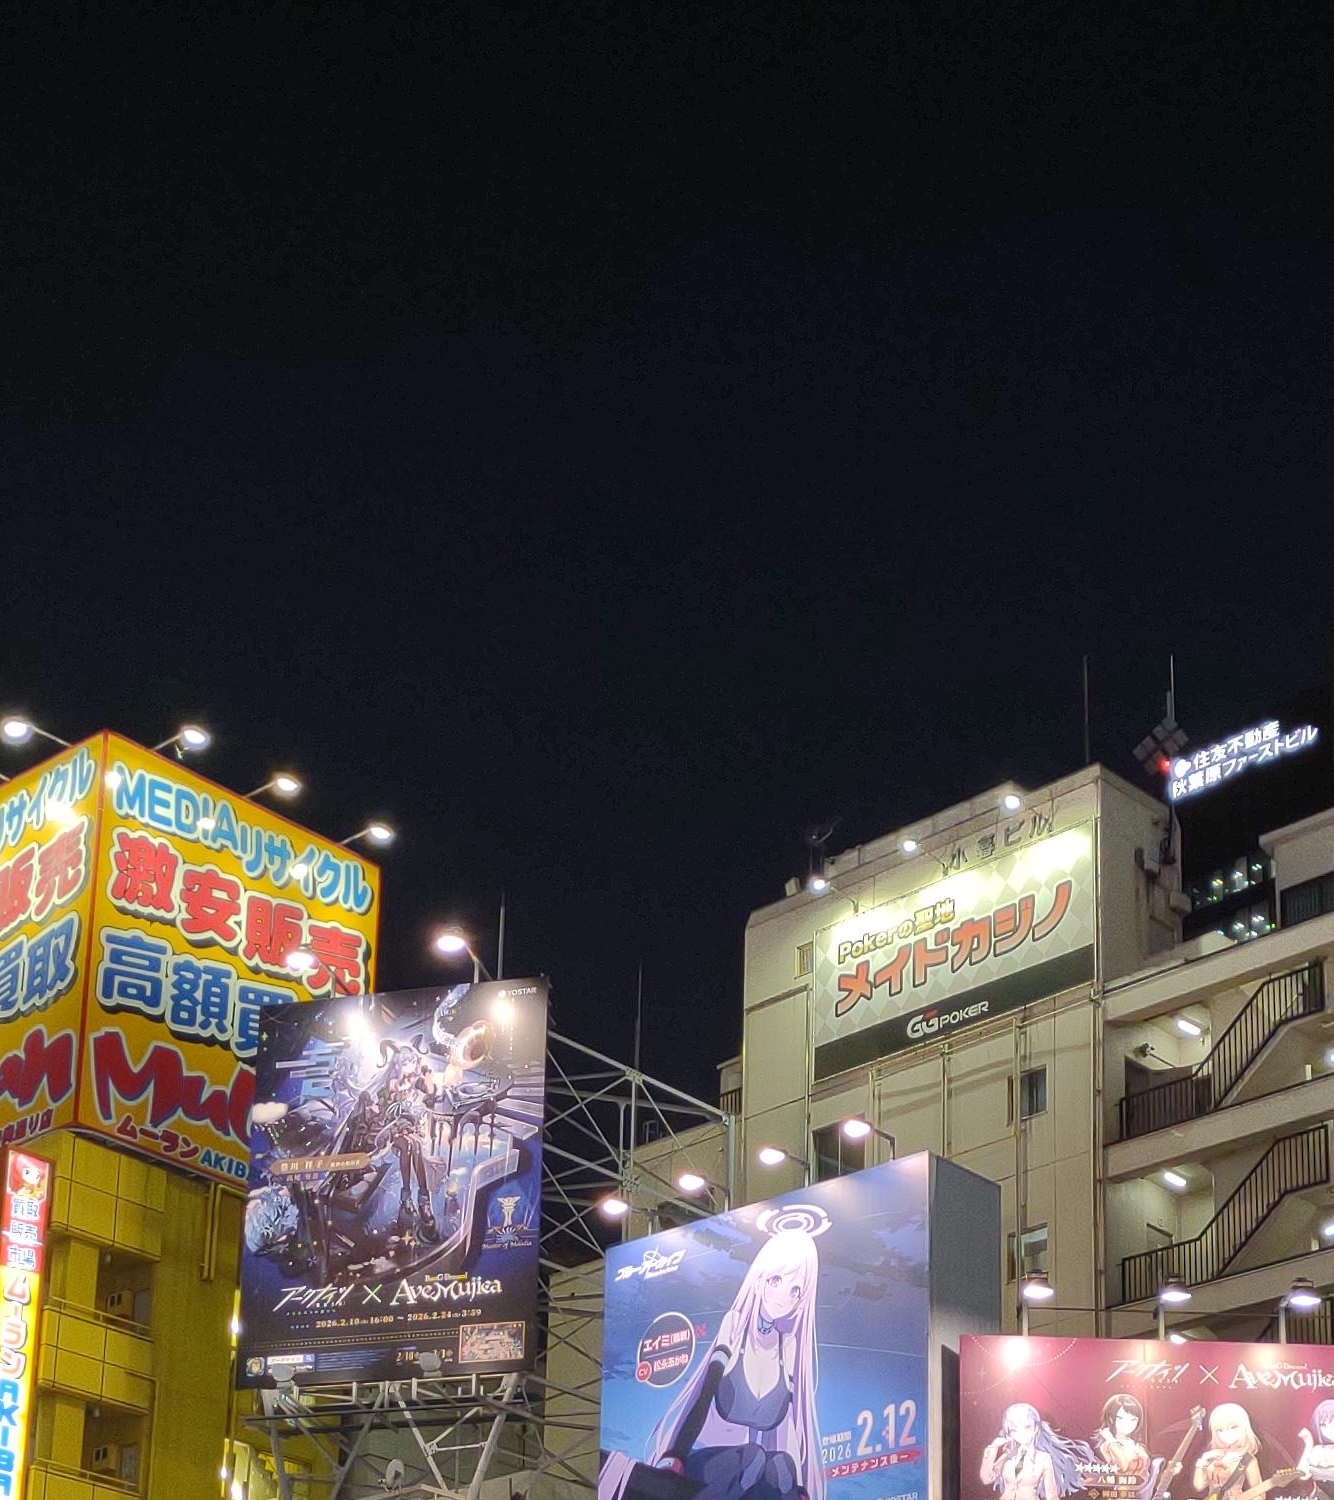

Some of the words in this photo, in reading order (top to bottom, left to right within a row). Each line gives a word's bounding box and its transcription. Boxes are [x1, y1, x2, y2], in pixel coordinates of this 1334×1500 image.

[1172, 725, 1319, 799] 秋葉原ファーストビル
[1193, 719, 1280, 771] 住友不動産
[105, 827, 366, 996] 激安販売
[834, 880, 1073, 1018] メイドカジノ
[97, 928, 287, 1057] 高額買
[821, 1442, 852, 1465] 2026
[856, 1399, 917, 1457] 2.12
